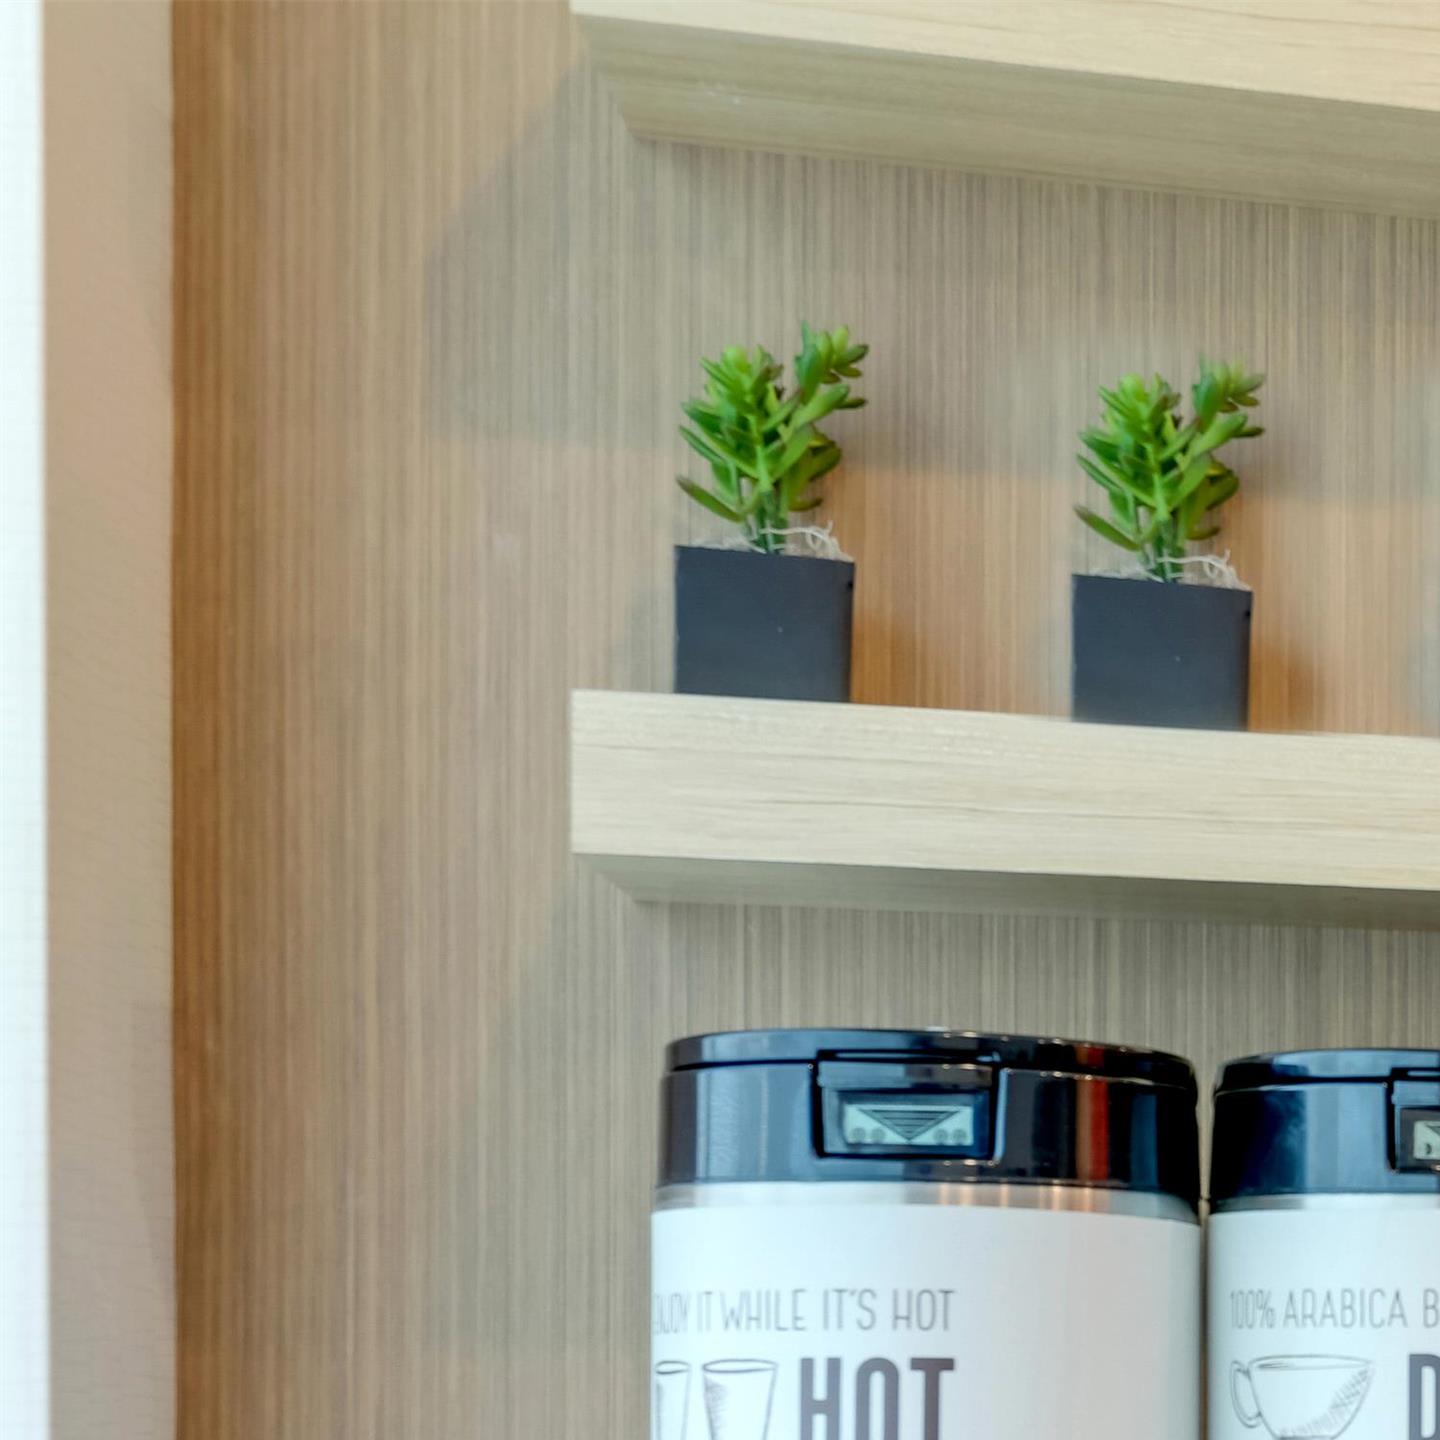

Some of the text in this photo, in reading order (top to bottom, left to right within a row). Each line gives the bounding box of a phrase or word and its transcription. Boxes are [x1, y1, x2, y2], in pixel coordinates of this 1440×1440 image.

[696, 1290, 713, 1331] IT
[719, 1289, 807, 1331] WHILE
[823, 1289, 877, 1331] IT'S
[892, 1289, 955, 1331] HOT
[1229, 1289, 1275, 1330] 100%
[1283, 1288, 1408, 1329] ARABICA
